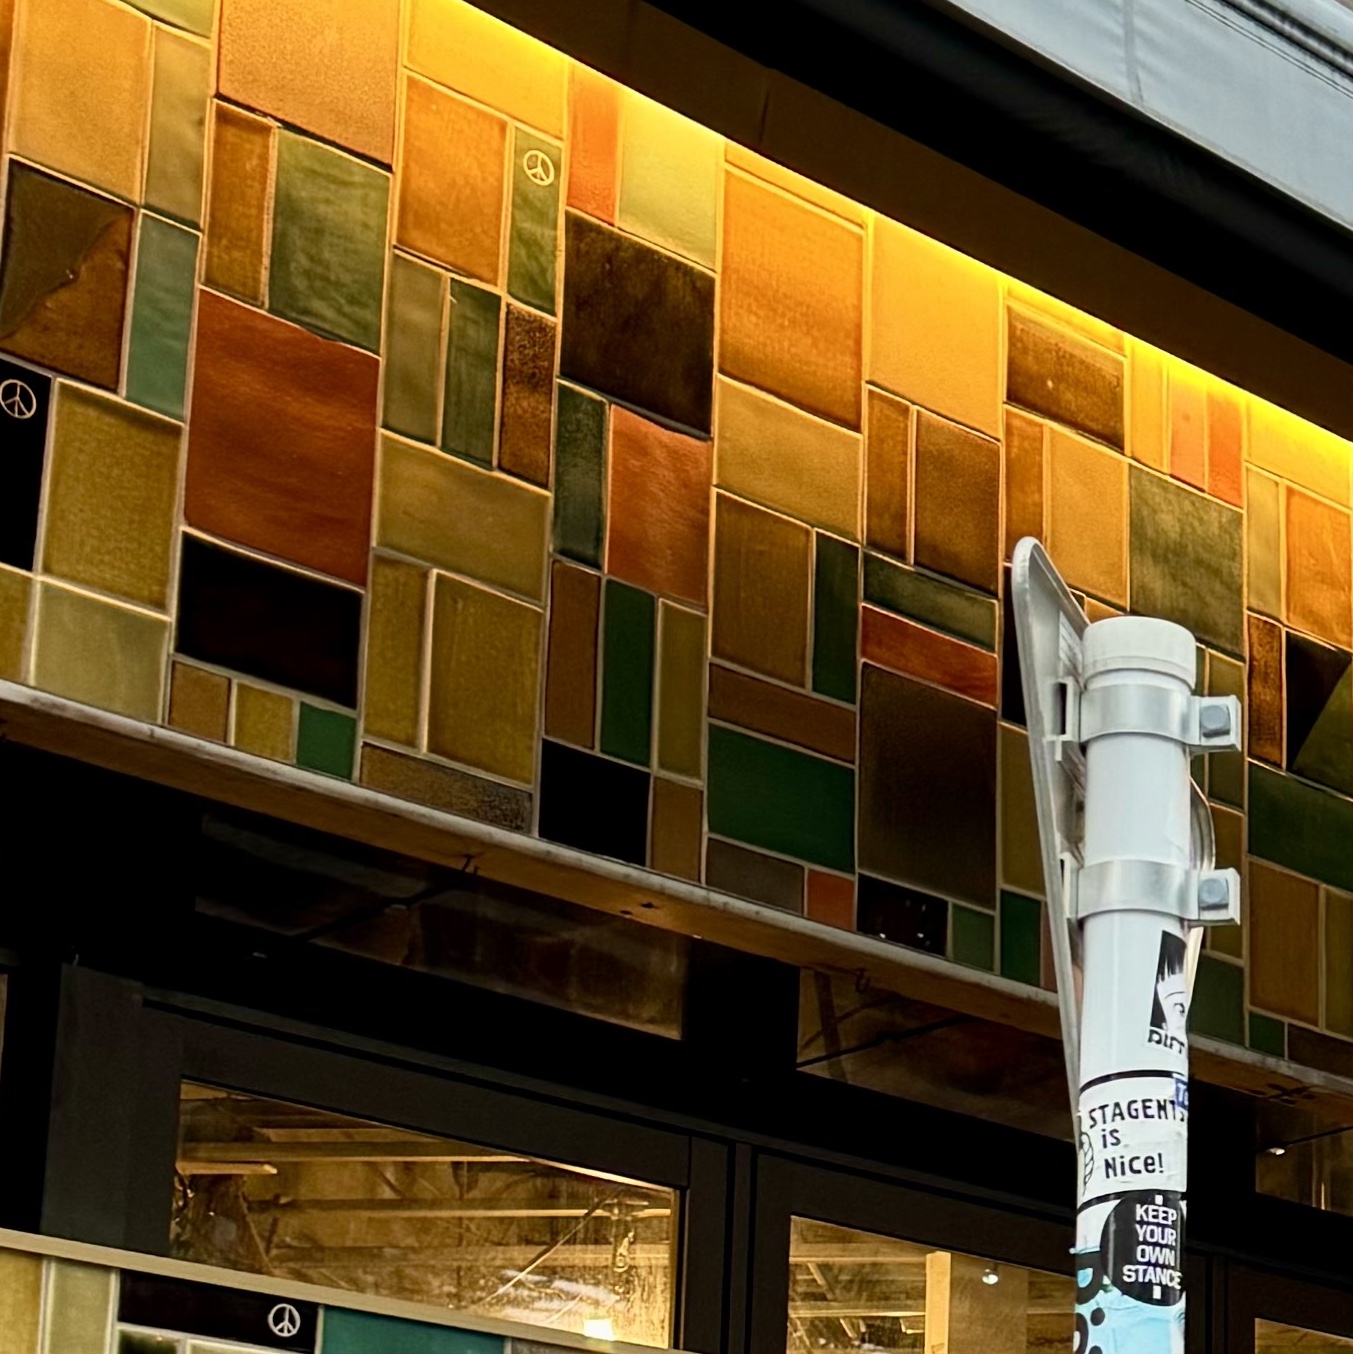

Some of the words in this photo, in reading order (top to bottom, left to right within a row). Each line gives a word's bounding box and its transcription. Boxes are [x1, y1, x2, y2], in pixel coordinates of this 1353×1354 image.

[1101, 1128, 1121, 1149] is
[1104, 1153, 1163, 1179] Nice!
[1135, 1204, 1177, 1225] KEEP
[1135, 1224, 1177, 1246] YOUR
[1136, 1245, 1175, 1267] OWN
[1122, 1265, 1182, 1289] STANCE
